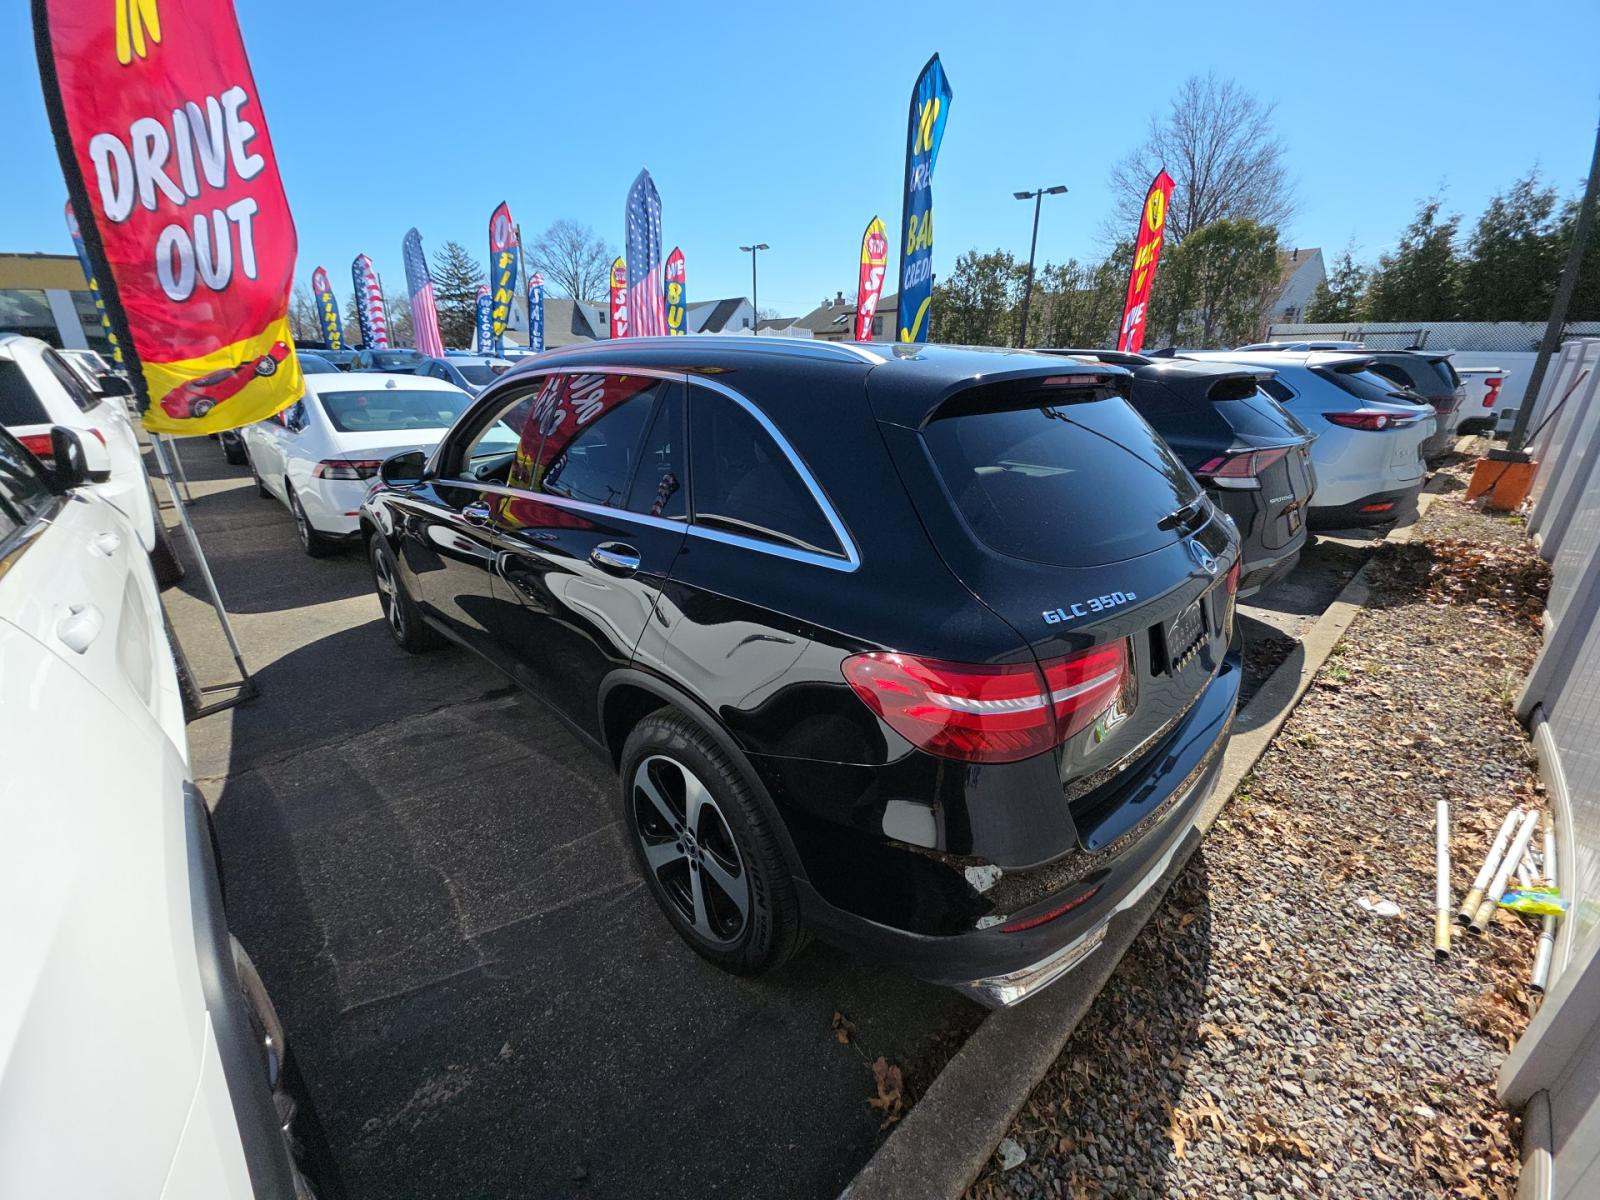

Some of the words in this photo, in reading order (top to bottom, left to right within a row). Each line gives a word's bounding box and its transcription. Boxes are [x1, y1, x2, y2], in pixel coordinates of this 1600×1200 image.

[88, 85, 264, 222] DRIVE
[155, 197, 258, 301] OUT
[1042, 602, 1088, 625] GLC
